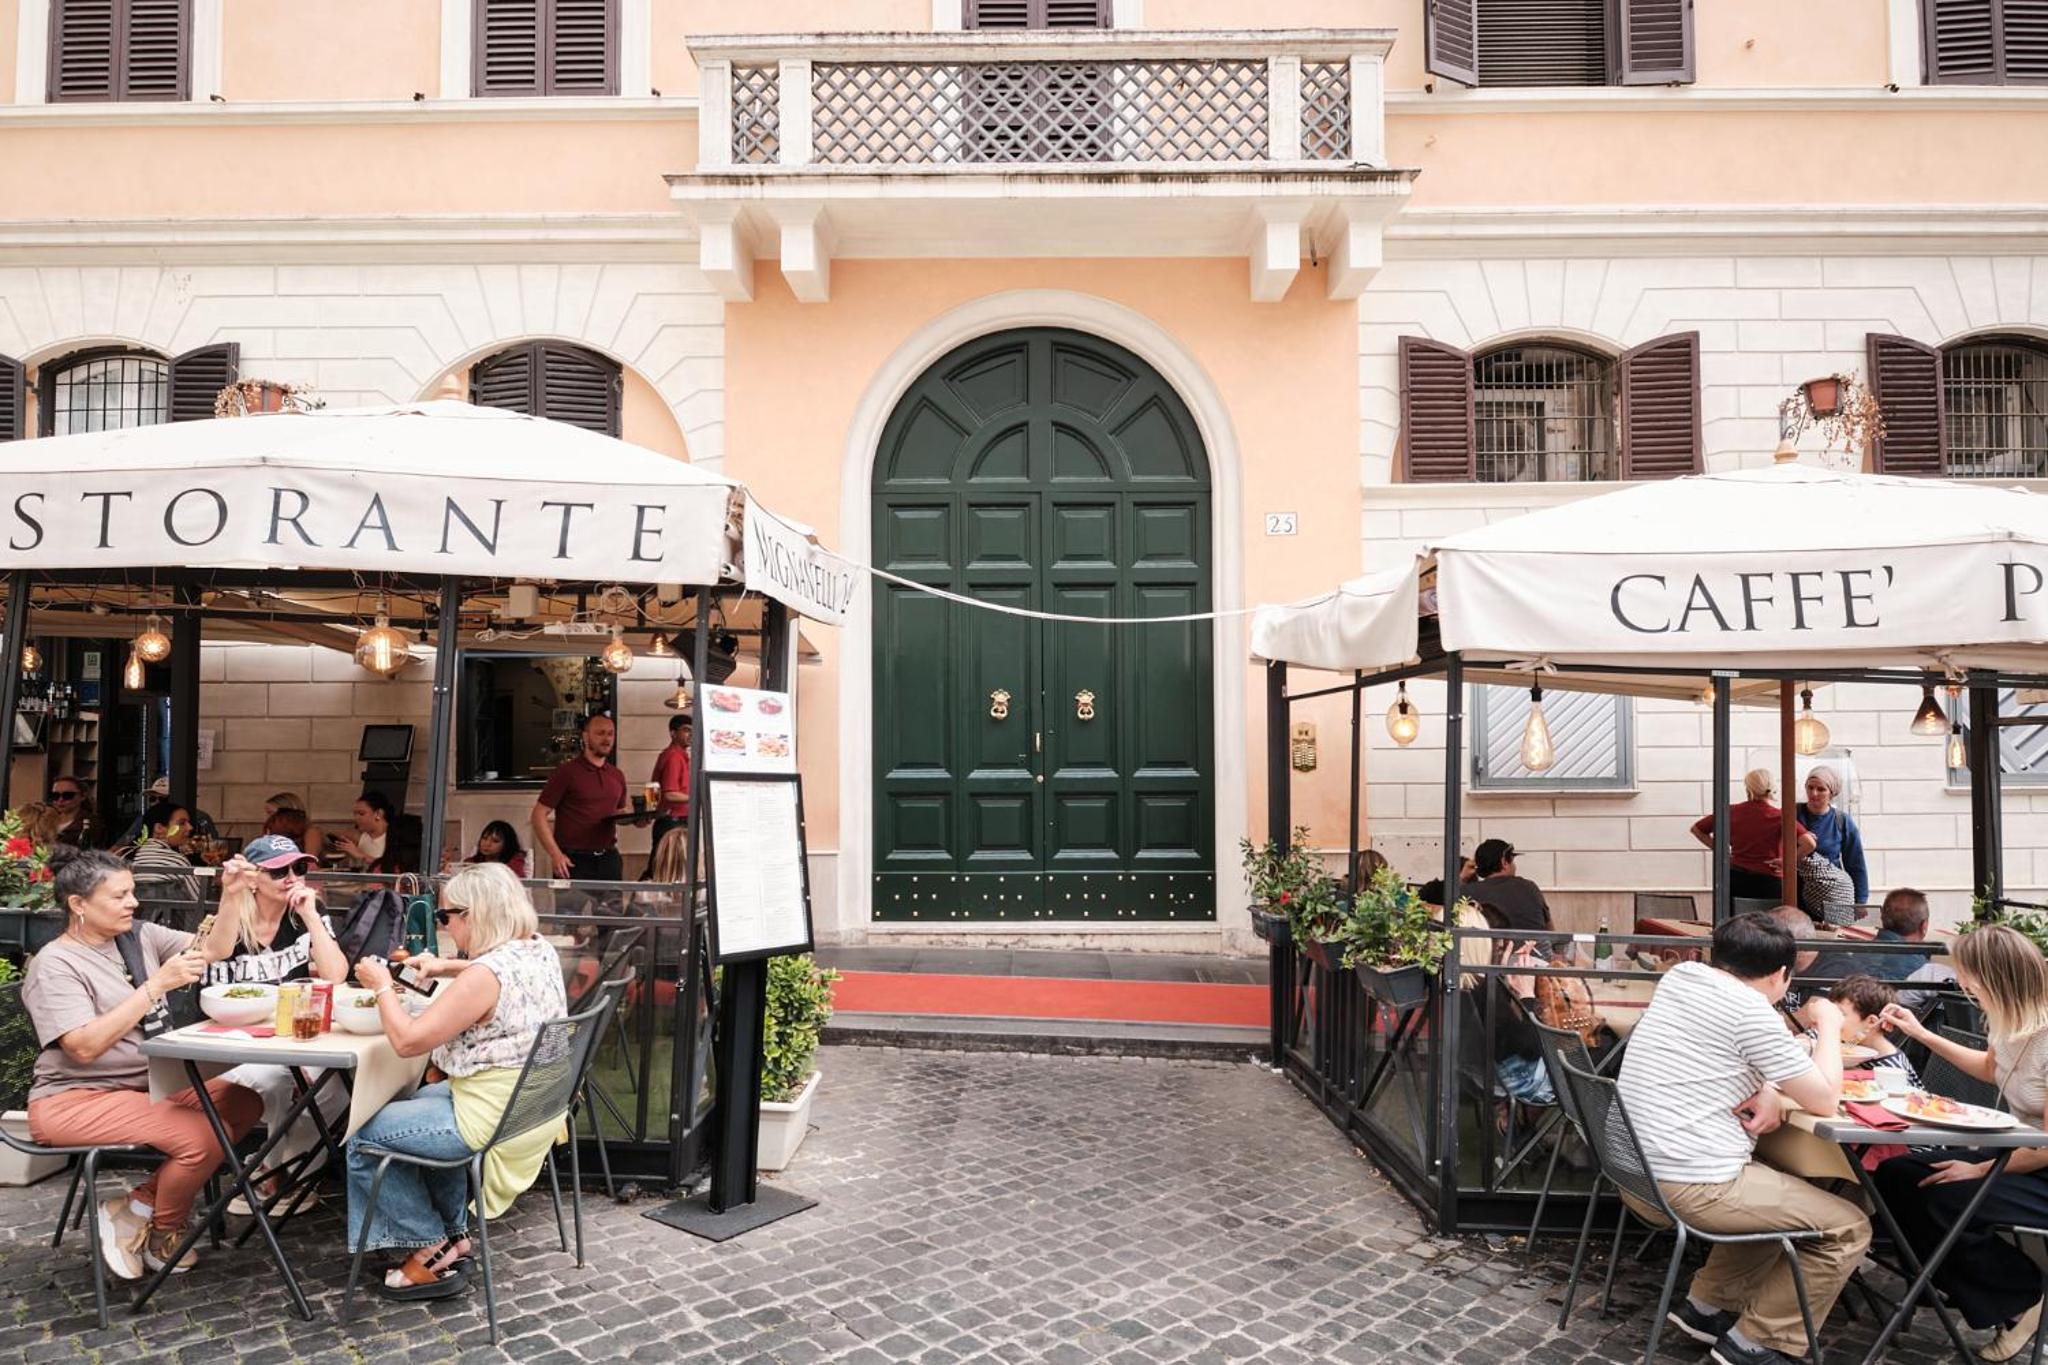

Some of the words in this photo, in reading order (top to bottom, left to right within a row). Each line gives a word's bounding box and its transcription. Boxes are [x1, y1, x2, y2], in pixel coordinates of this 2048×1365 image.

[9, 486, 667, 562] STORANTE
[1269, 515, 1293, 533] 25
[1611, 565, 1893, 633] CAFFE'
[1996, 563, 2043, 622] P
